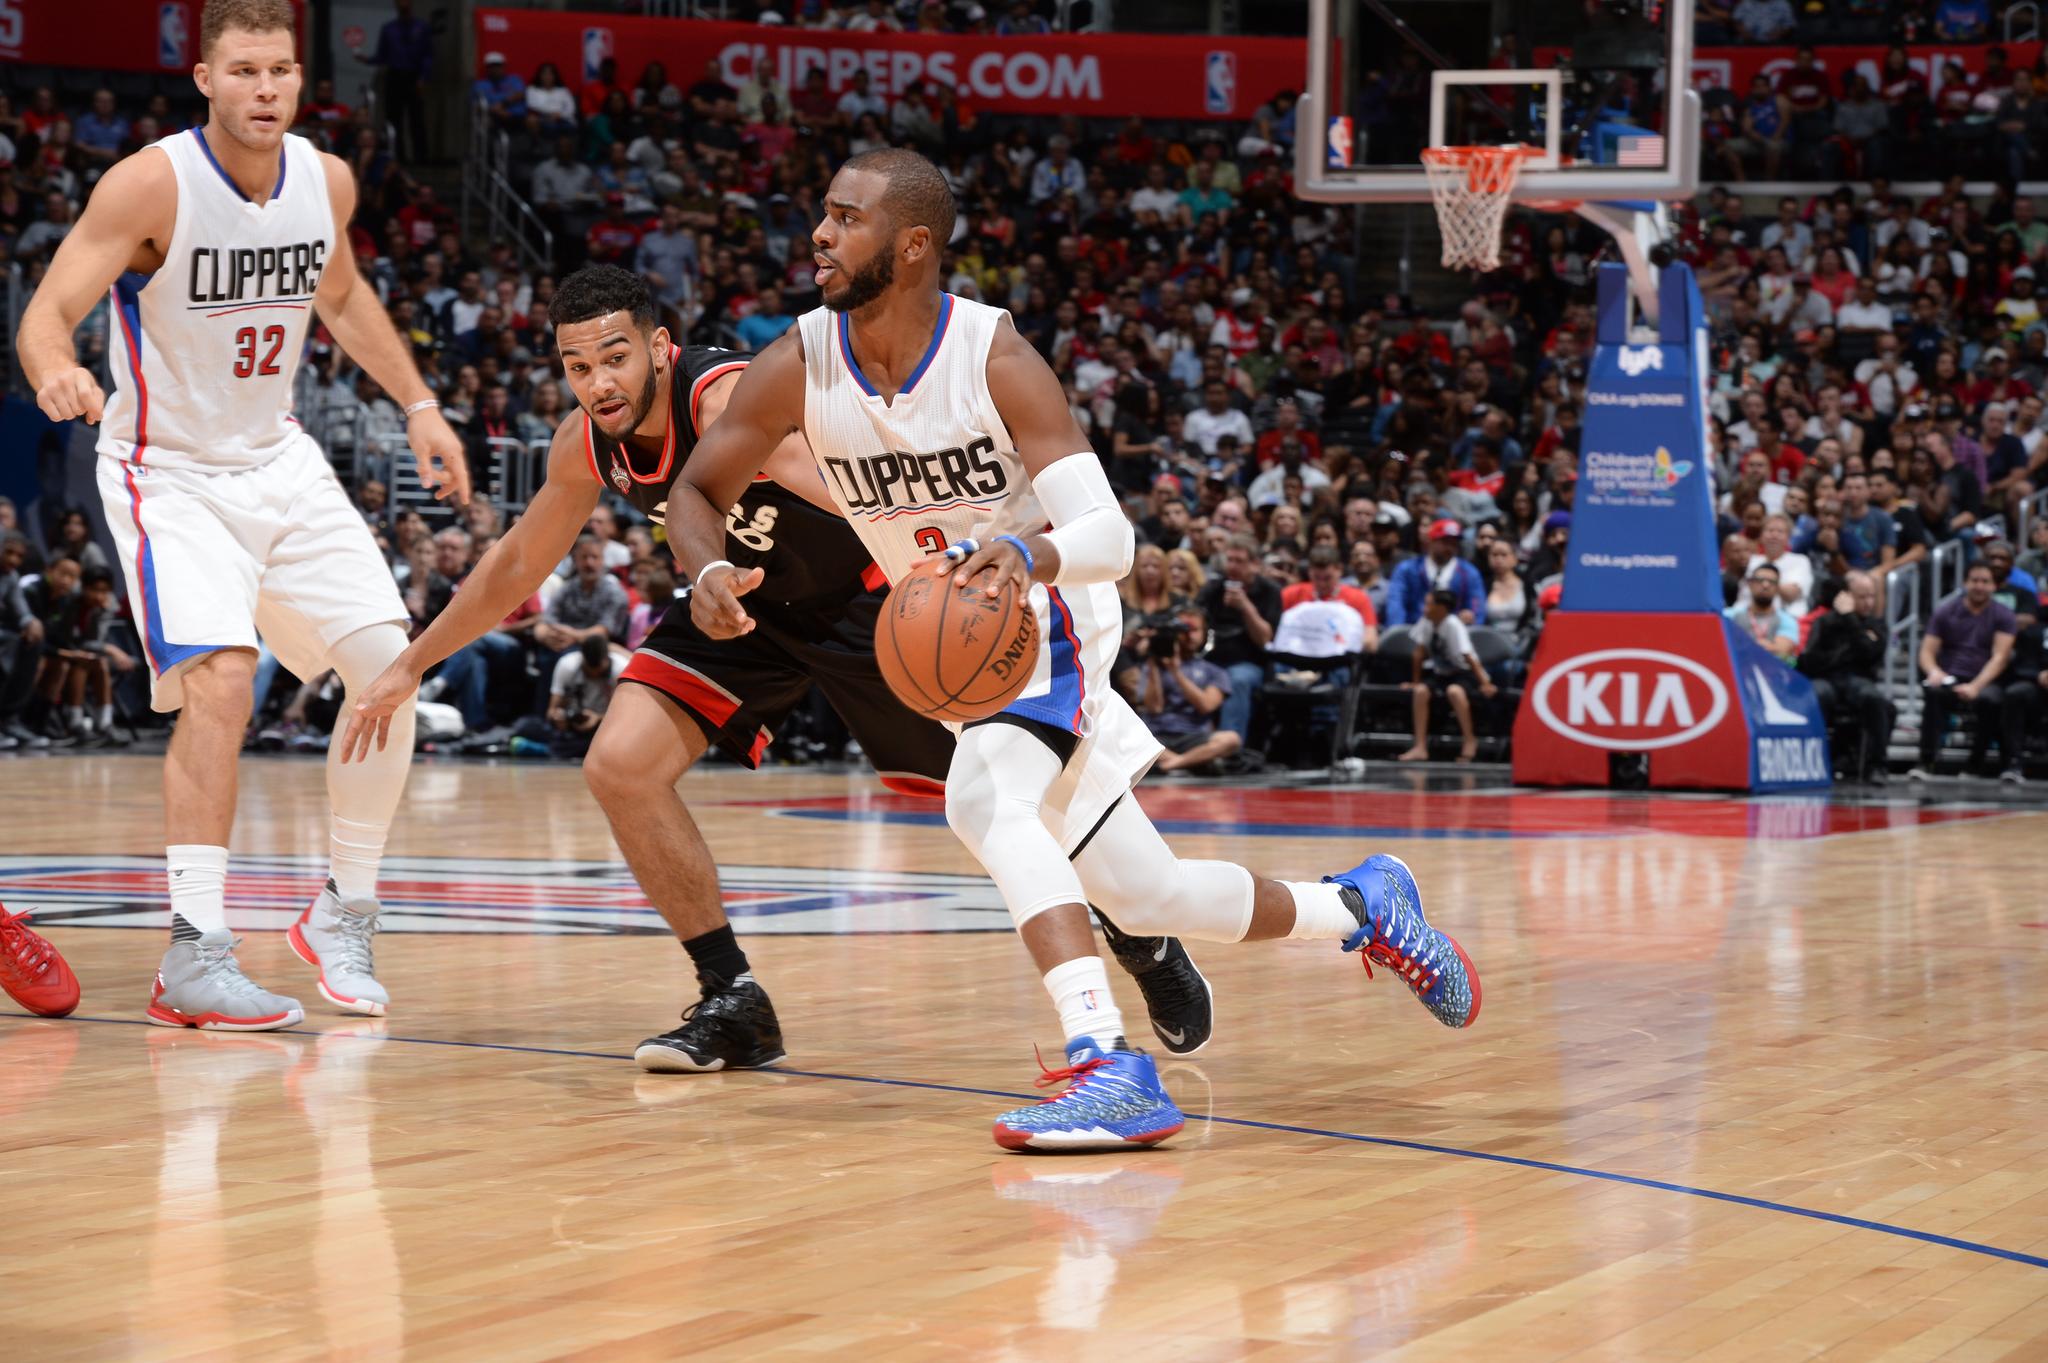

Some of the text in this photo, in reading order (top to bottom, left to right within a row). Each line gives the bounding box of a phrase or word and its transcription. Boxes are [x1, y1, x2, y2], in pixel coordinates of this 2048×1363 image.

[188, 239, 325, 302] CLIPPERS
[233, 325, 285, 378] 32
[824, 436, 1007, 508] CLIPPERS
[989, 605, 1033, 681] ALDING
[1567, 672, 1694, 726] KIA
